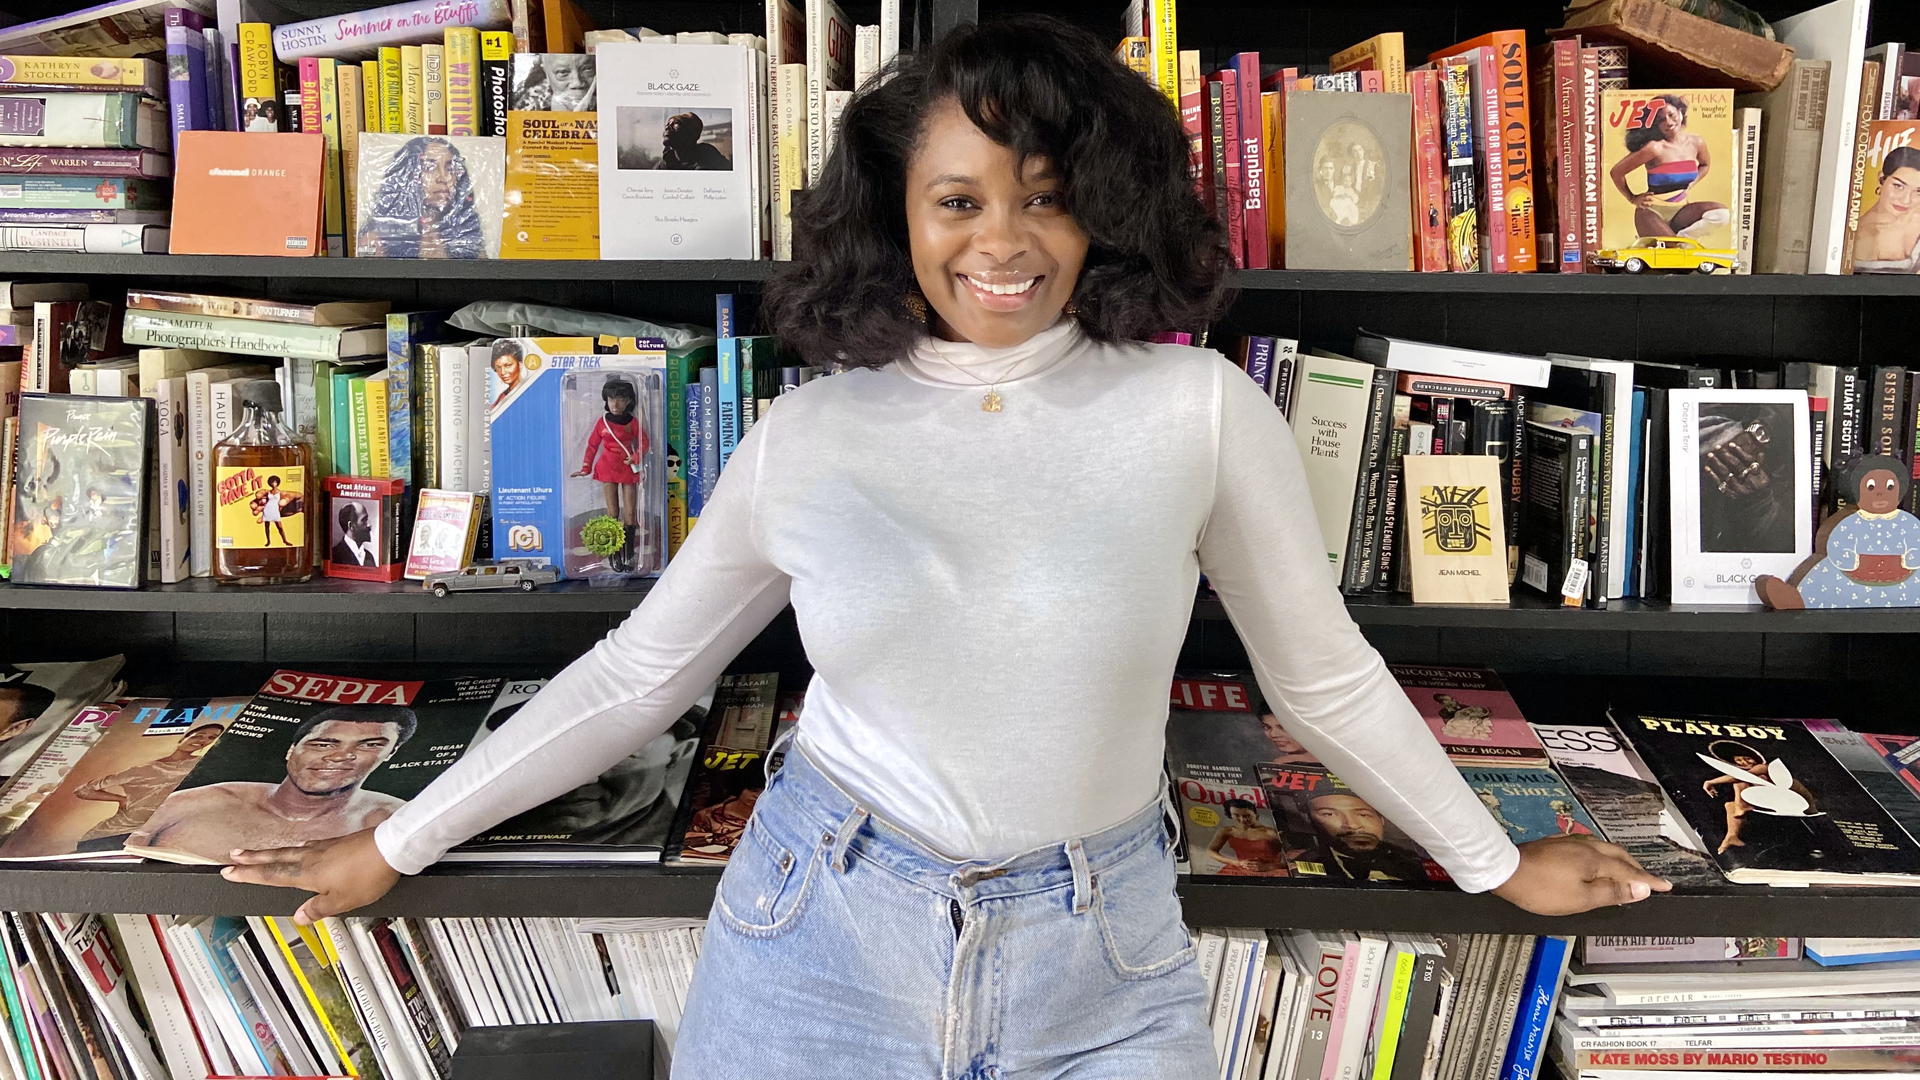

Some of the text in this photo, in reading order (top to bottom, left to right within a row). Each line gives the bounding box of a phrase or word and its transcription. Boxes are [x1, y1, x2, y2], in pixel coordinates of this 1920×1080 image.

[334, 0, 480, 41] Summer on the Bluffs
[281, 24, 324, 40] SUNNY
[281, 34, 328, 51] HOSTIN
[24, 62, 80, 70] KATHRYN
[245, 30, 258, 94] CRAWFORD
[258, 44, 270, 80] ROBYN
[427, 54, 440, 83] IDA
[648, 82, 675, 91] BLACK
[770, 54, 778, 122] INTERPRETING
[388, 80, 400, 115] RADIANCE
[449, 63, 474, 136] WRITING
[1680, 93, 1728, 104] CHAKA
[811, 80, 820, 158] GIFTS TO MAKE
[1182, 105, 1202, 116] THINK
[1502, 42, 1532, 185] SOUL CITY
[1610, 98, 1667, 130] JET
[772, 124, 780, 152] BASIC
[1211, 97, 1224, 174] BONE BLACK
[1584, 68, 1596, 202] AFRICAN-AMERICAN
[1748, 125, 1756, 142] RUN
[1486, 88, 1504, 212] STYLING FOR INSTAGRAM
[1746, 144, 1754, 169] WHILE
[252, 169, 286, 177] ORANGE
[1244, 138, 1262, 210] Basquiat
[1745, 170, 1754, 186] THE
[1744, 187, 1752, 204] SUN
[1744, 205, 1751, 213] IS
[1511, 202, 1520, 238] Healy
[1586, 206, 1598, 244] FIRSTS
[1742, 214, 1750, 230] HOT
[20, 236, 80, 247] BUSHNELL
[31, 229, 67, 237] CANDACE
[146, 329, 290, 354] Photographer's Handbook
[551, 356, 600, 368] STAR TREK
[669, 358, 681, 442] RICH PEOPLE
[1882, 372, 1896, 420] SISTER
[160, 400, 170, 437] YOGA
[704, 385, 712, 451] COMMON
[722, 401, 734, 448] FARMING
[1311, 416, 1348, 430] Success
[1841, 375, 1855, 456] STUART SCOTT
[196, 418, 204, 448] GILBERT
[355, 392, 369, 476] INVISIBLE MAN
[376, 396, 389, 476] BOUGHT ANDY WARHOL
[1318, 427, 1338, 438] with
[1682, 402, 1690, 453] Cheryse Terry
[43, 425, 118, 458] Purple Rain
[688, 400, 700, 478] the Airbnb story
[1311, 436, 1340, 449] House
[1434, 438, 1444, 454] ALEX
[1310, 446, 1339, 459] Plants
[218, 468, 256, 494] GOTTA
[220, 476, 263, 506] HAVE IT
[336, 482, 376, 492] Great African
[340, 490, 372, 498] Americans
[672, 506, 681, 546] KEVIN
[1716, 574, 1747, 584] BLACK
[264, 672, 408, 706] SEPIA
[458, 688, 494, 697] WRITING
[468, 683, 498, 691] BLACK
[472, 678, 502, 686] CRISIS
[738, 680, 768, 688] SAFARI
[244, 710, 300, 724] MUHAMMAD
[250, 704, 268, 712] THE
[232, 722, 274, 734] NOBODY
[239, 716, 256, 724] ALI
[1640, 718, 1787, 741] PLAYBOY
[228, 728, 264, 738] KNOWS
[430, 744, 464, 752] DREAM
[1452, 746, 1522, 756] INEZ HOGAN
[389, 758, 454, 770] BLACK STATE
[704, 752, 760, 771] JET
[1272, 772, 1323, 792] JET
[1502, 786, 1567, 798] SHOES
[1180, 781, 1270, 810] Quick
[525, 833, 572, 842] STEWART
[1203, 940, 1216, 976] FAIRY TALES
[328, 923, 388, 1051] VOGUE COLORING BOOK
[1220, 948, 1238, 1018] SPRING/SUMMER 2017
[1310, 952, 1342, 1022] LOVE
[1280, 996, 1288, 1016] VOGUE
[1500, 973, 1522, 1037] COMPOSITION
[1524, 986, 1550, 1062] Henri Matisse
[1311, 1030, 1324, 1041] 13
[1593, 1040, 1623, 1048] FASHION
[1590, 1053, 1828, 1066] KATE MOSS BY MARIO TESTINO
